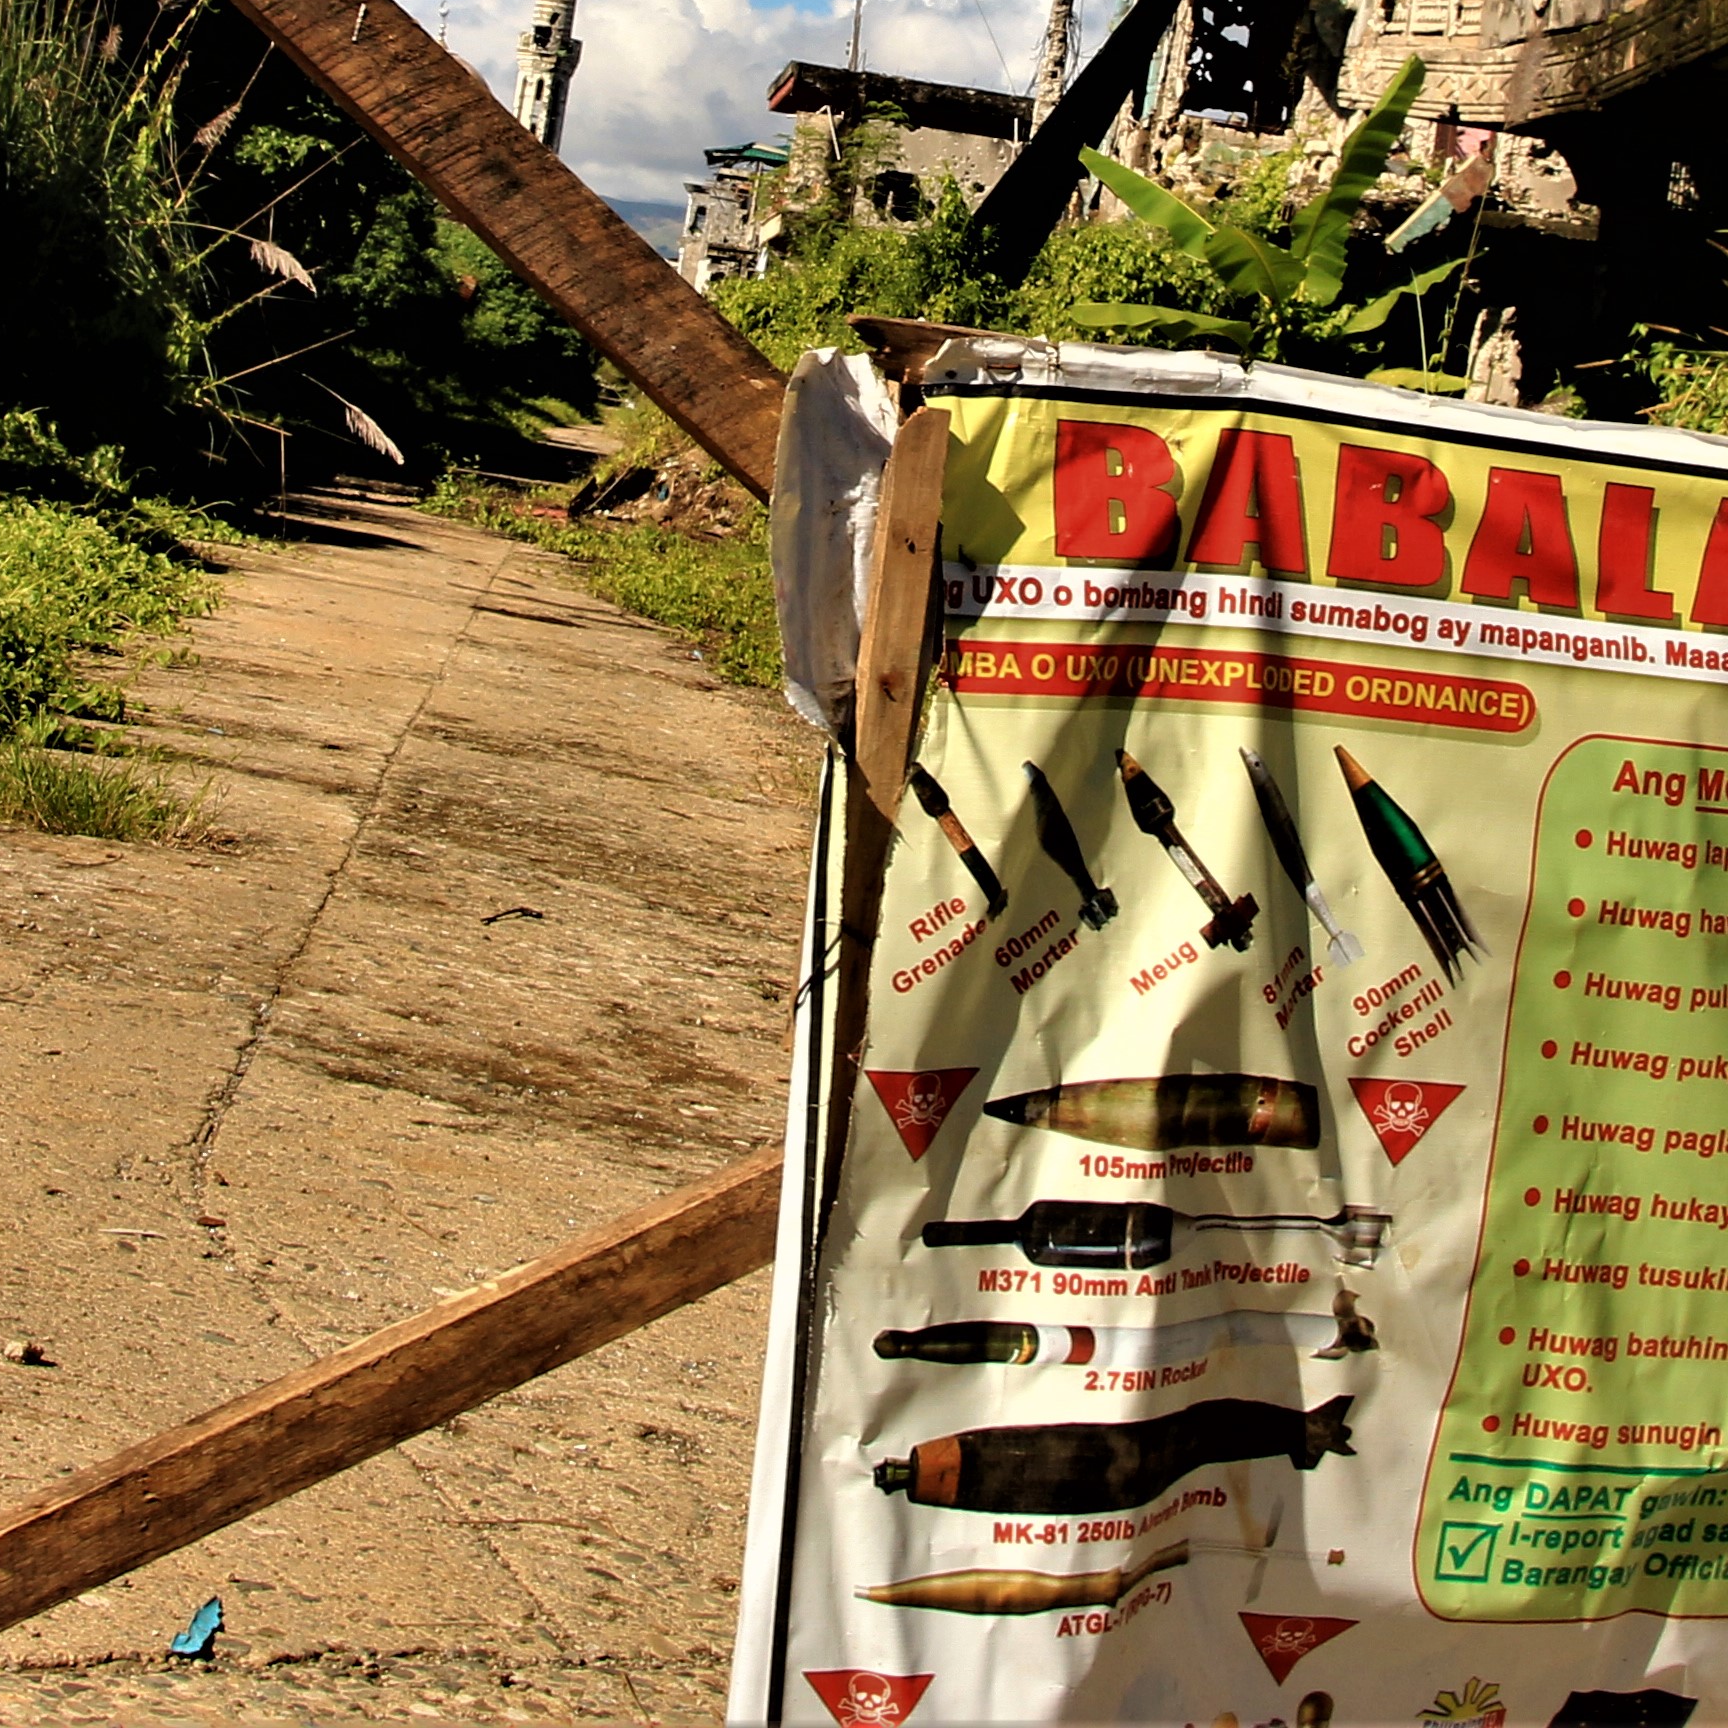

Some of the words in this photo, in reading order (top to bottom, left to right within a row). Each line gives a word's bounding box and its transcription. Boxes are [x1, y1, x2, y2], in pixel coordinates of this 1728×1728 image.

[972, 575, 1043, 606] UXO
[1053, 585, 1073, 607] o
[1084, 579, 1207, 618] bombang
[1218, 586, 1283, 619] hindi
[1289, 599, 1429, 642] sumabog
[1437, 619, 1471, 647] ay
[1478, 620, 1657, 664] mapanganib.
[1030, 653, 1055, 681] O
[1066, 654, 1119, 682] UXO
[1126, 655, 1336, 698] (UNEXPLODED
[1344, 674, 1531, 721] ORDNANCE)
[1612, 759, 1686, 806] Ang
[1606, 830, 1697, 869] Huwag
[907, 894, 967, 945] Rifle
[993, 906, 1062, 969] 60mm
[1597, 899, 1692, 938] Huwag
[890, 915, 988, 996] Grenade
[1009, 927, 1081, 996] Mortar
[1128, 939, 1200, 997] Meug
[1351, 960, 1423, 1018] 90mm
[1584, 971, 1681, 1011] Huwag
[1345, 978, 1446, 1059] Cockerill
[1393, 1008, 1455, 1059] Shell
[1570, 1041, 1669, 1080] Huwag
[1560, 1115, 1655, 1152] Huwag
[1079, 1155, 1167, 1179] 105mm
[1170, 1151, 1254, 1178] Projectile
[1553, 1187, 1641, 1222] Huwag
[978, 1270, 1042, 1293] M371
[1052, 1273, 1128, 1296] 90mm
[1135, 1271, 1177, 1297] Anti
[1181, 1265, 1213, 1290] Tank
[1213, 1260, 1311, 1284] Projectile
[1542, 1257, 1629, 1290] Huwag
[1527, 1327, 1618, 1363] Huwag
[1626, 1332, 1728, 1362] batuhin
[1084, 1370, 1157, 1392] 2.75IN
[1521, 1365, 1593, 1394] UXO.
[1510, 1412, 1609, 1449] Huwag
[1616, 1420, 1722, 1451] sunugin
[1447, 1475, 1514, 1513] Ang
[1524, 1482, 1633, 1512] DAPAT
[1639, 1485, 1728, 1520] gawin:
[993, 1521, 1069, 1545] MK-81
[1077, 1517, 1136, 1542] 250lb
[1508, 1520, 1625, 1552] I-report
[1631, 1517, 1696, 1549] agad
[1500, 1558, 1638, 1588] Barangay
